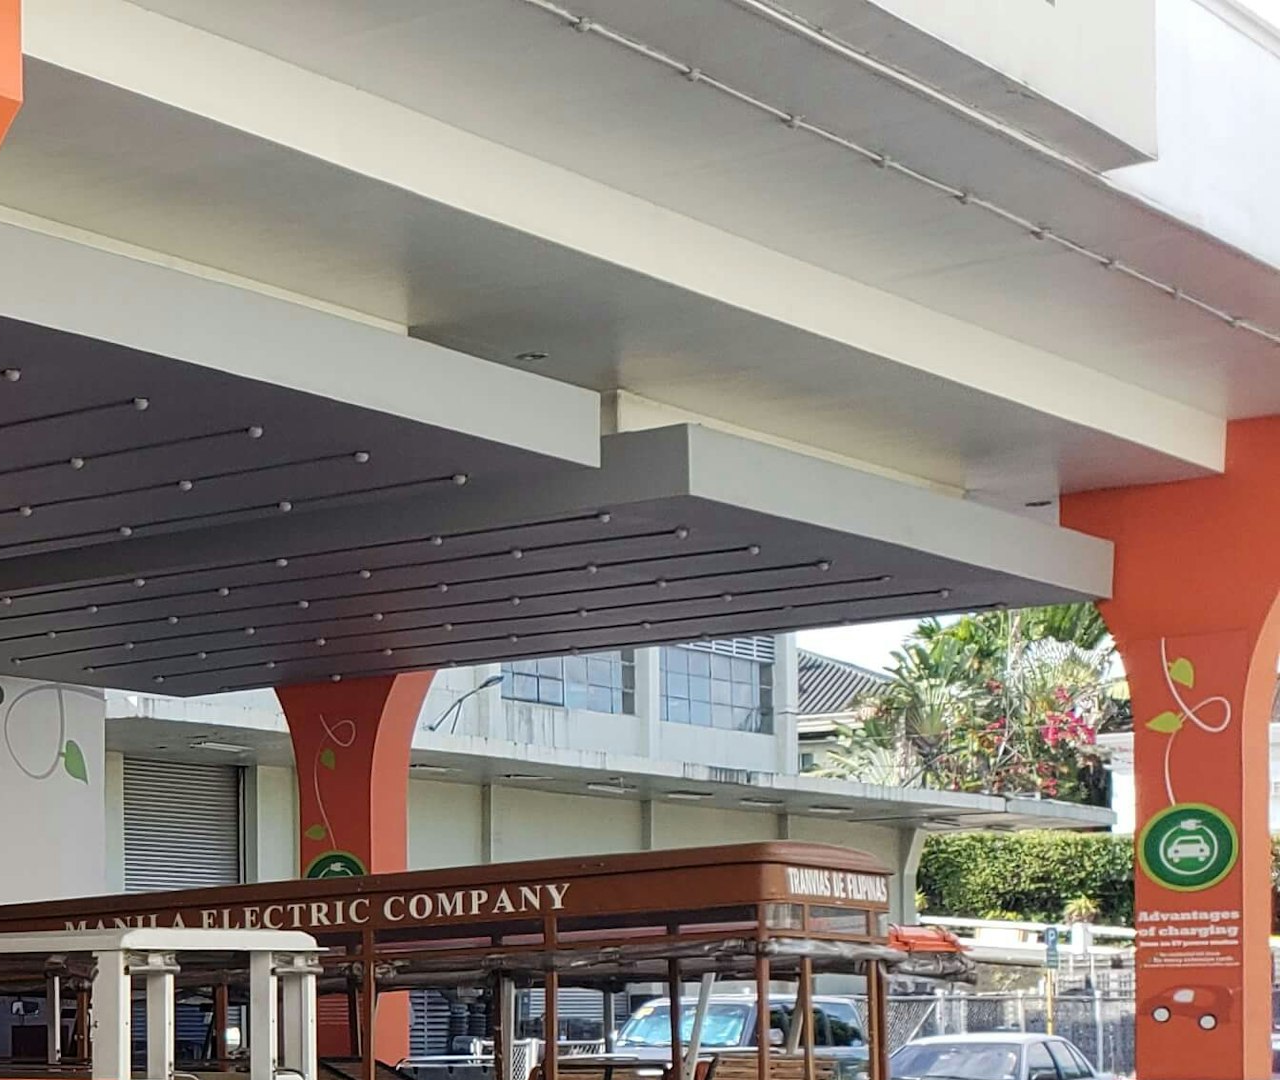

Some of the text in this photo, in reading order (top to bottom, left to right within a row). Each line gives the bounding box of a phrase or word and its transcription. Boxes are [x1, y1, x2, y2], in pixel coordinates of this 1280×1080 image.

[832, 871, 847, 899] DE
[201, 898, 371, 931] ELECTRIC
[382, 882, 571, 923] COMPANY
[1138, 910, 1240, 923] Advantages
[1138, 925, 1239, 939] of charging
